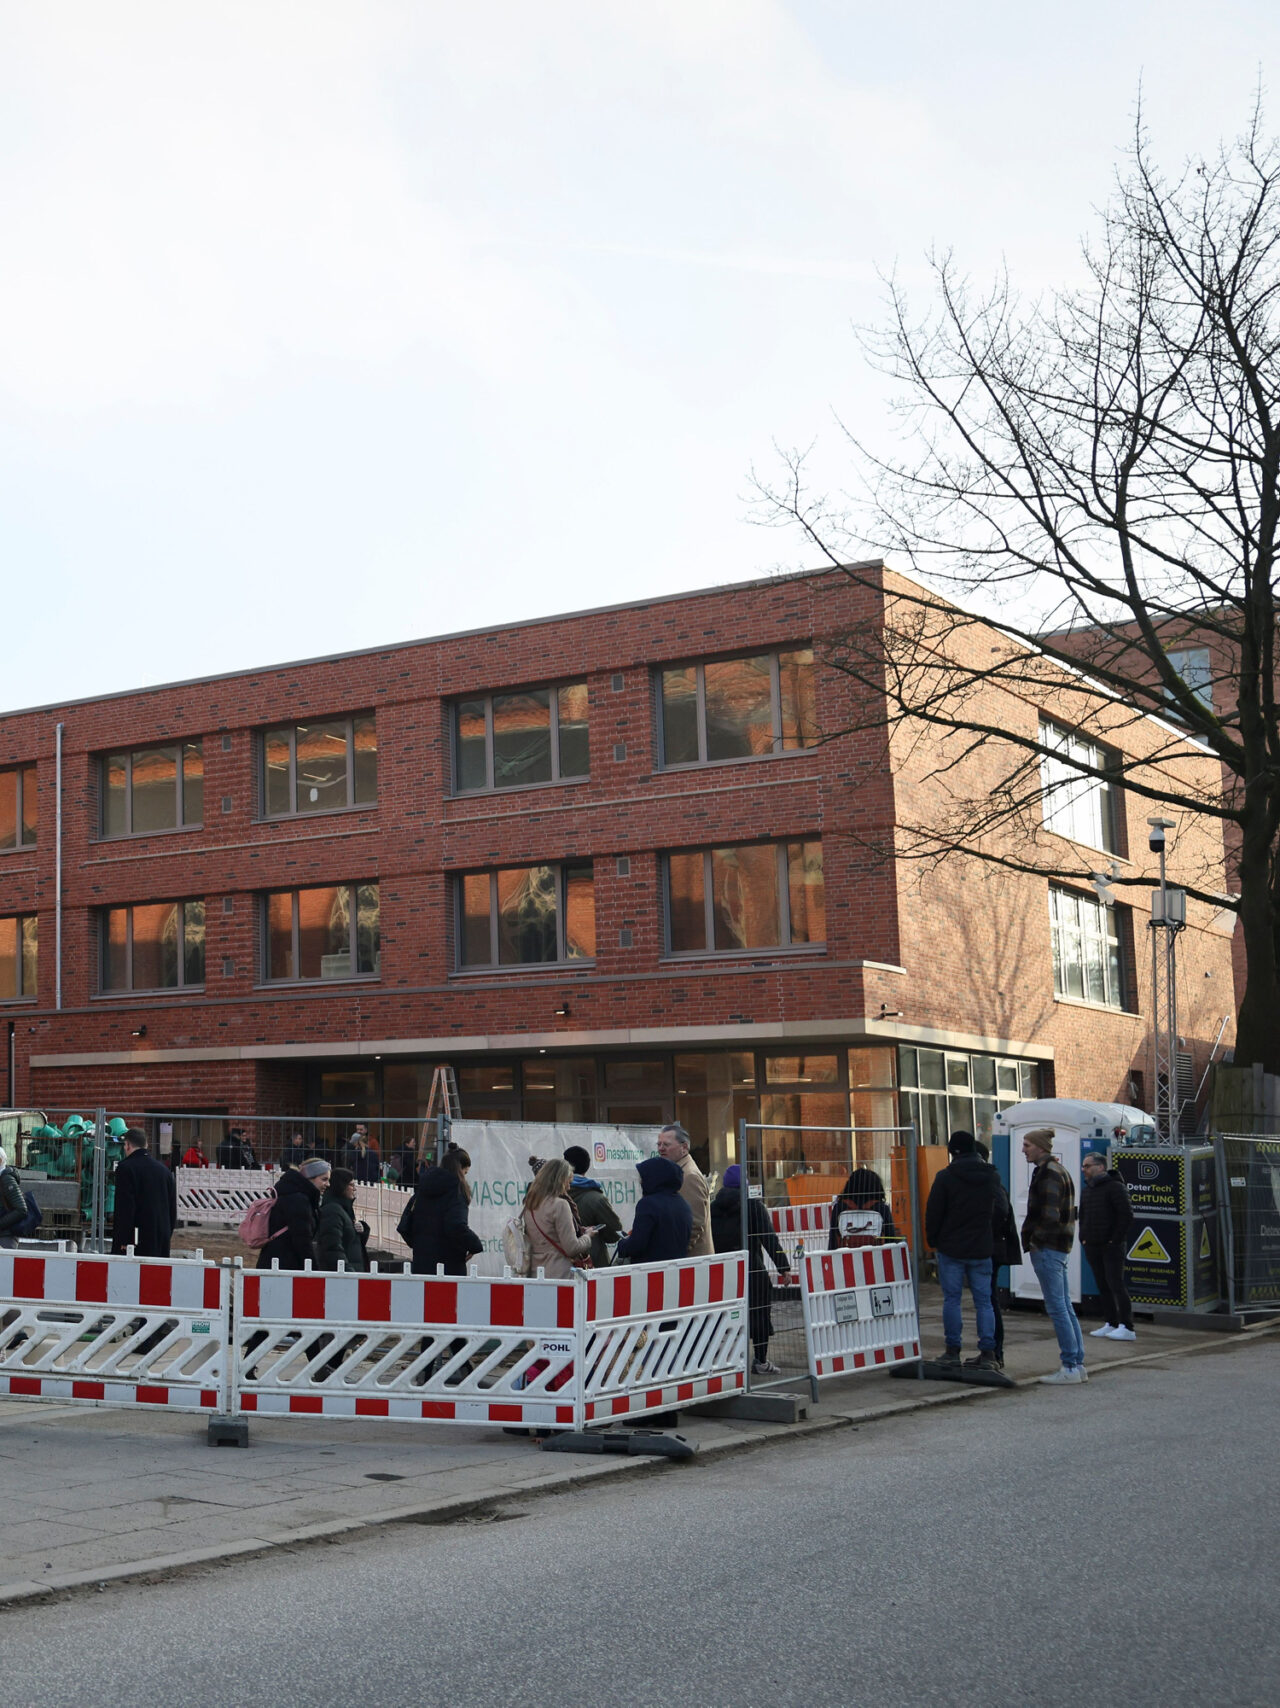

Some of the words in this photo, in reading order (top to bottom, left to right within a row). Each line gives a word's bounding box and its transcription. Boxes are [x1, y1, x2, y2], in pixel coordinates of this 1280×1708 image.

[470, 1181, 528, 1206] MASCH
[600, 1181, 636, 1205] MBH
[1131, 1193, 1175, 1204] CHTUNG
[480, 1235, 504, 1253] arte
[543, 1343, 570, 1351] POHL
